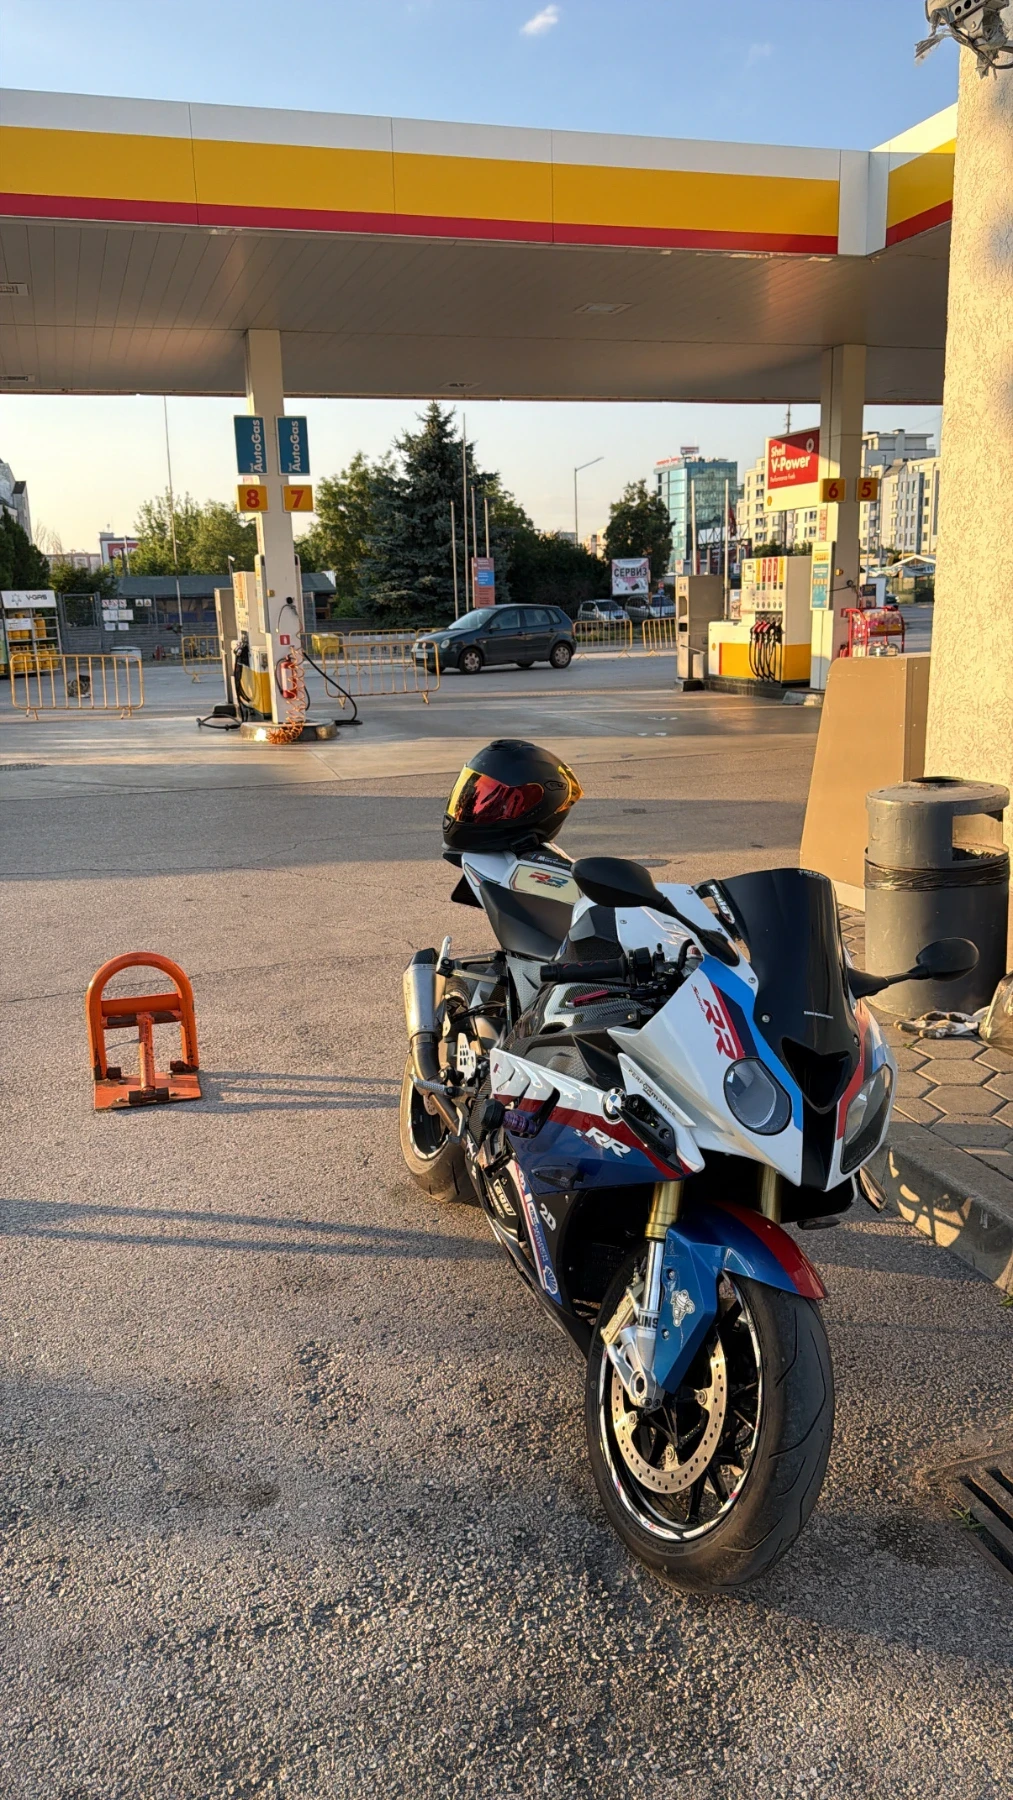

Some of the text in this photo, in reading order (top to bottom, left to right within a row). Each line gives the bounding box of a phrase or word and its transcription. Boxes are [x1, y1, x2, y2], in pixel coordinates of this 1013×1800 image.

[251, 419, 264, 472] AutoGas
[290, 420, 301, 472] AutoGas
[771, 443, 786, 458] Shell
[771, 455, 811, 473] V-Power
[246, 489, 260, 508] 8
[828, 482, 839, 499] 6
[861, 481, 872, 498] 5
[290, 490, 304, 508] 7
[614, 567, 648, 577] СЕРВИЗ
[529, 871, 569, 887] RR
[702, 998, 738, 1060] RR
[585, 1127, 632, 1158] RR
[539, 1203, 557, 1231] 2D
